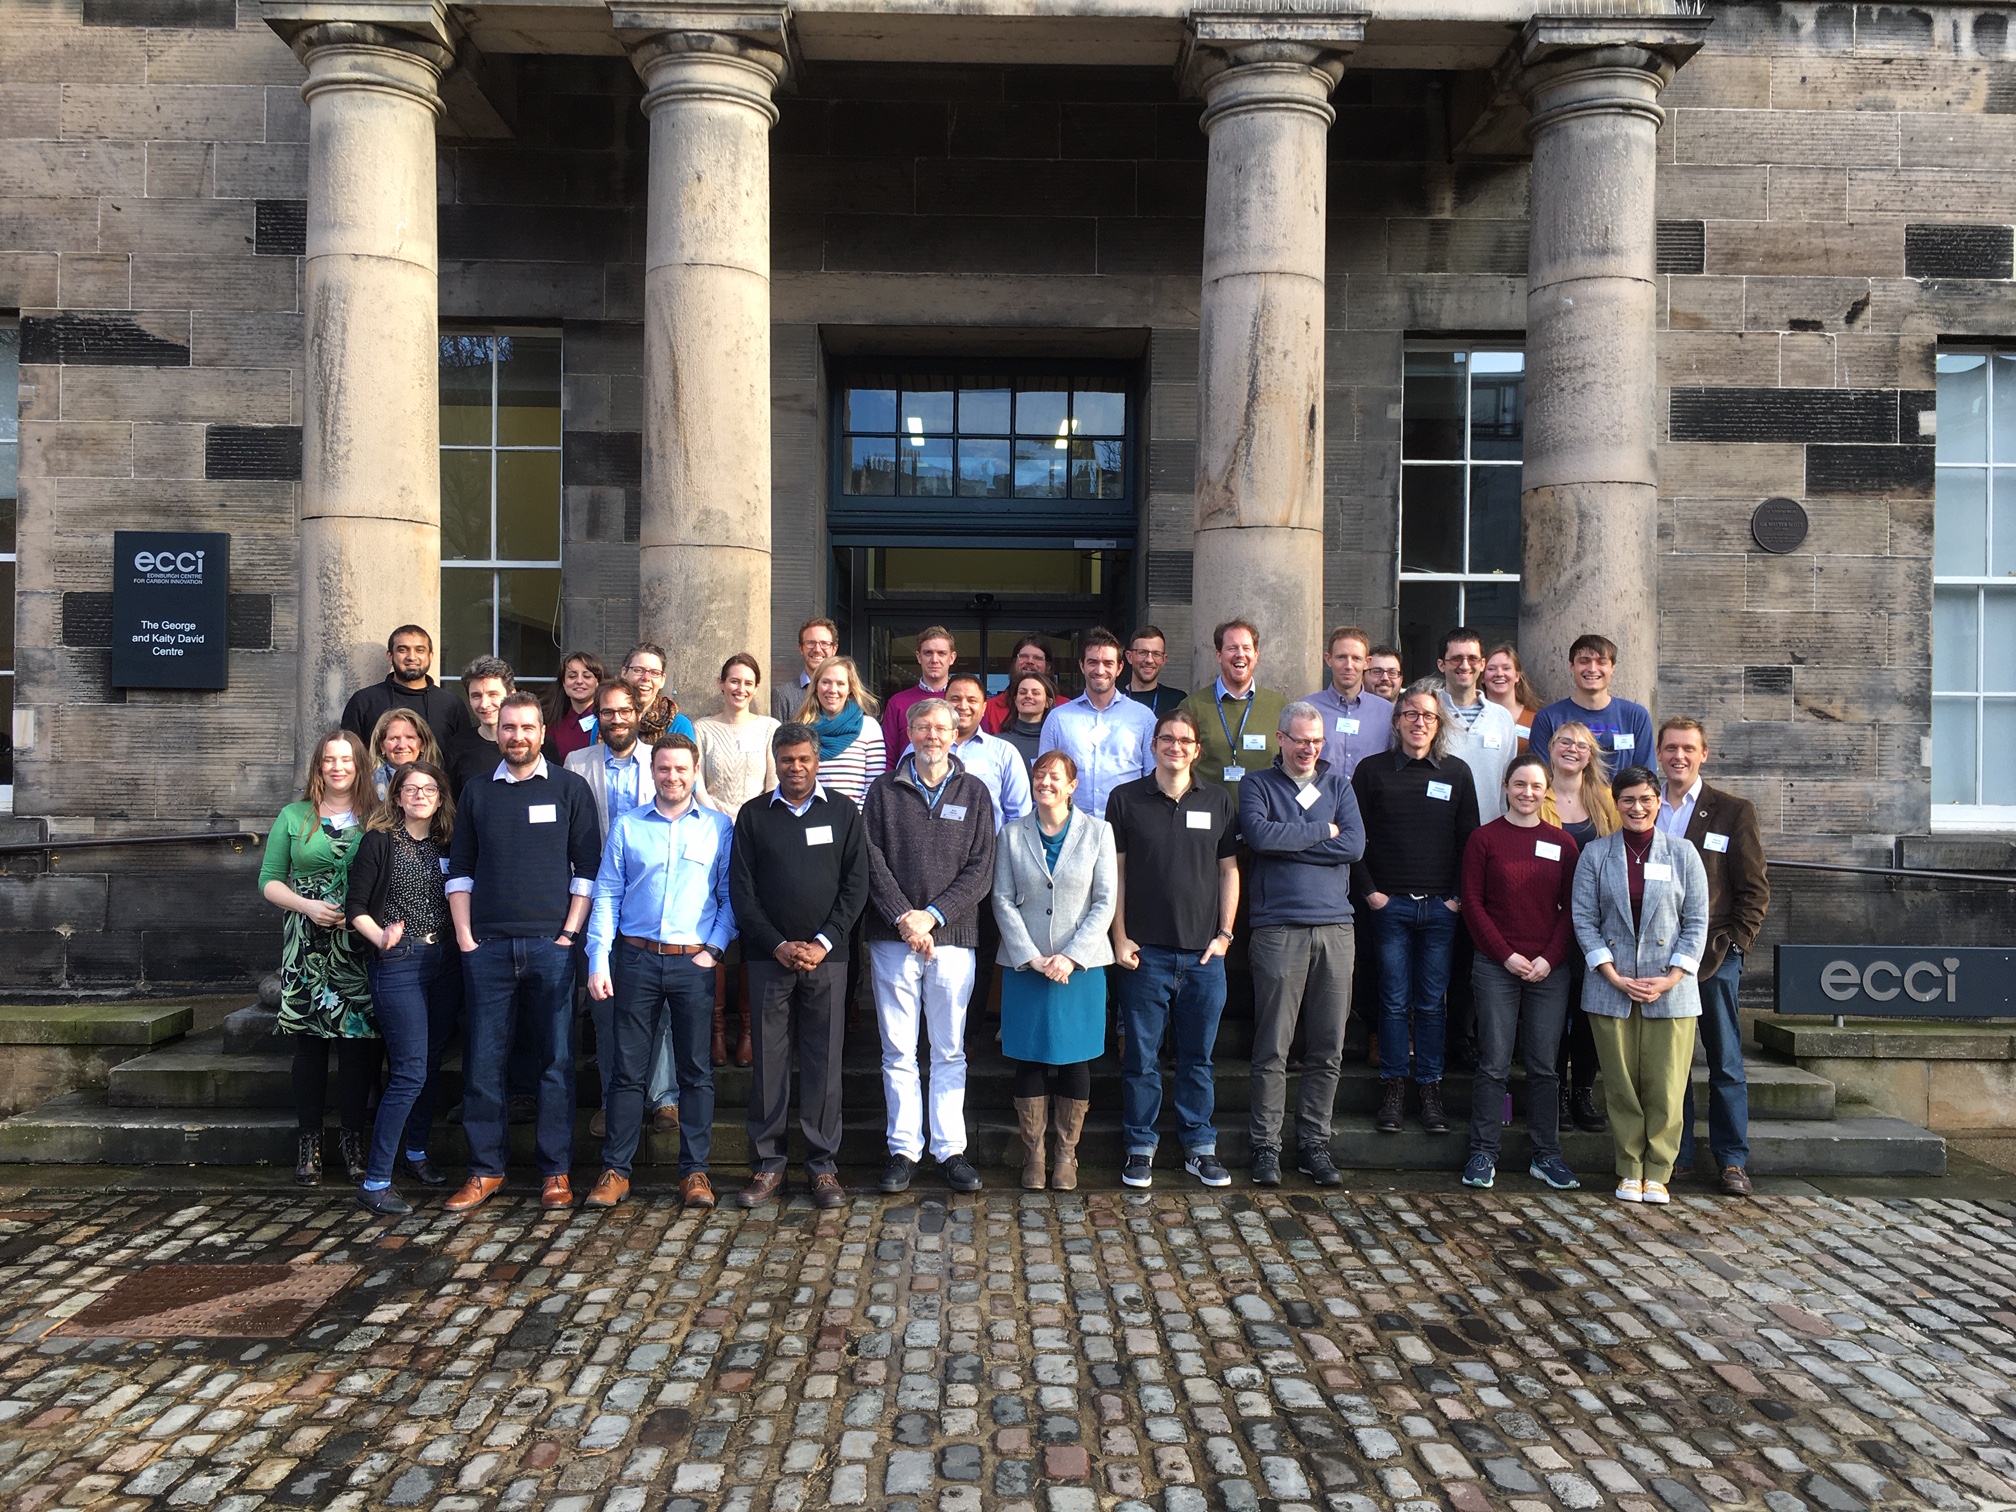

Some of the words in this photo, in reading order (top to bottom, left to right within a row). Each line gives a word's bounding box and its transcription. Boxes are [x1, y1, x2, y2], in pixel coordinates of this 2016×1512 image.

[134, 550, 205, 573] ecci
[141, 620, 159, 630] The
[161, 621, 196, 632] George
[131, 634, 150, 643] and
[152, 634, 176, 645] Kaity
[178, 635, 205, 643] David
[152, 646, 184, 656] Centre
[1820, 957, 1960, 1003] ecci
